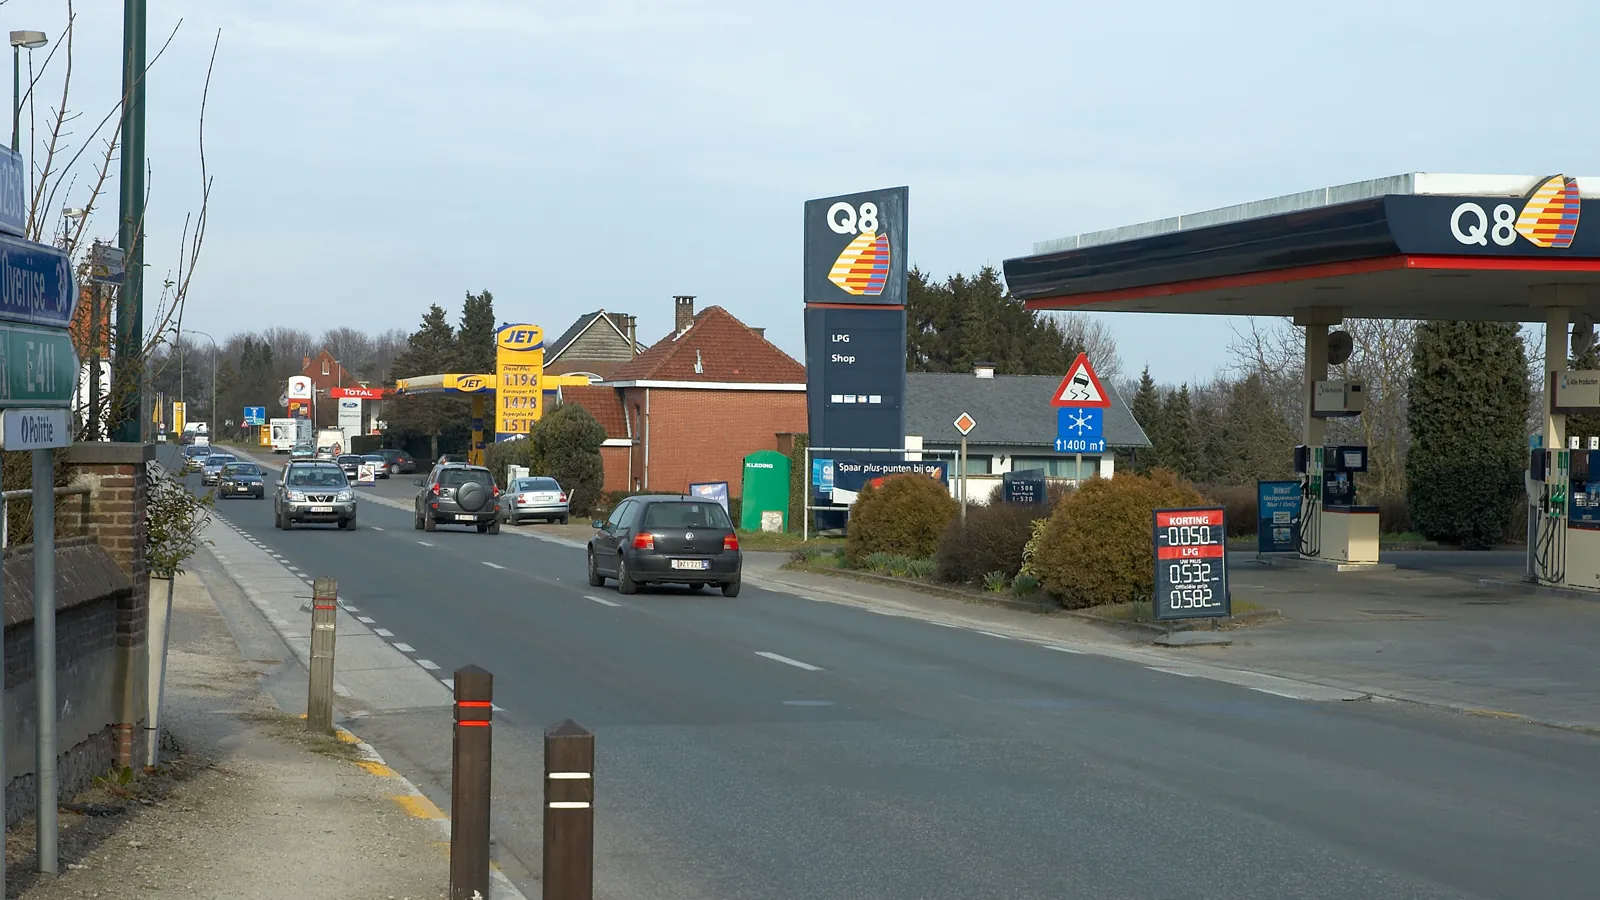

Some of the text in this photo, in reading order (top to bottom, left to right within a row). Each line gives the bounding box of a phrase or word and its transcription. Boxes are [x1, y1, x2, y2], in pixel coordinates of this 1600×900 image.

[0, 160, 21, 220] 253
[827, 202, 878, 234] Q8
[1450, 202, 1518, 246] Q8
[2, 250, 45, 321] Overijse
[504, 330, 538, 343] JET
[832, 334, 850, 343] LPG
[831, 354, 856, 364] Shop
[27, 341, 55, 392] E411
[462, 379, 482, 388] JET
[504, 374, 537, 387] 1.196
[503, 396, 537, 409] 1.478
[30, 416, 53, 443] Politie
[1063, 439, 1086, 450] 1400
[839, 463, 861, 473] Spaar
[863, 463, 912, 474] plus-punten
[914, 463, 925, 474] bij
[1283, 501, 1297, 509] Only
[1169, 516, 1209, 526] KORTING
[1182, 547, 1199, 556] LPG
[1169, 563, 1211, 584] 0.532
[1170, 589, 1213, 609] 0.582
